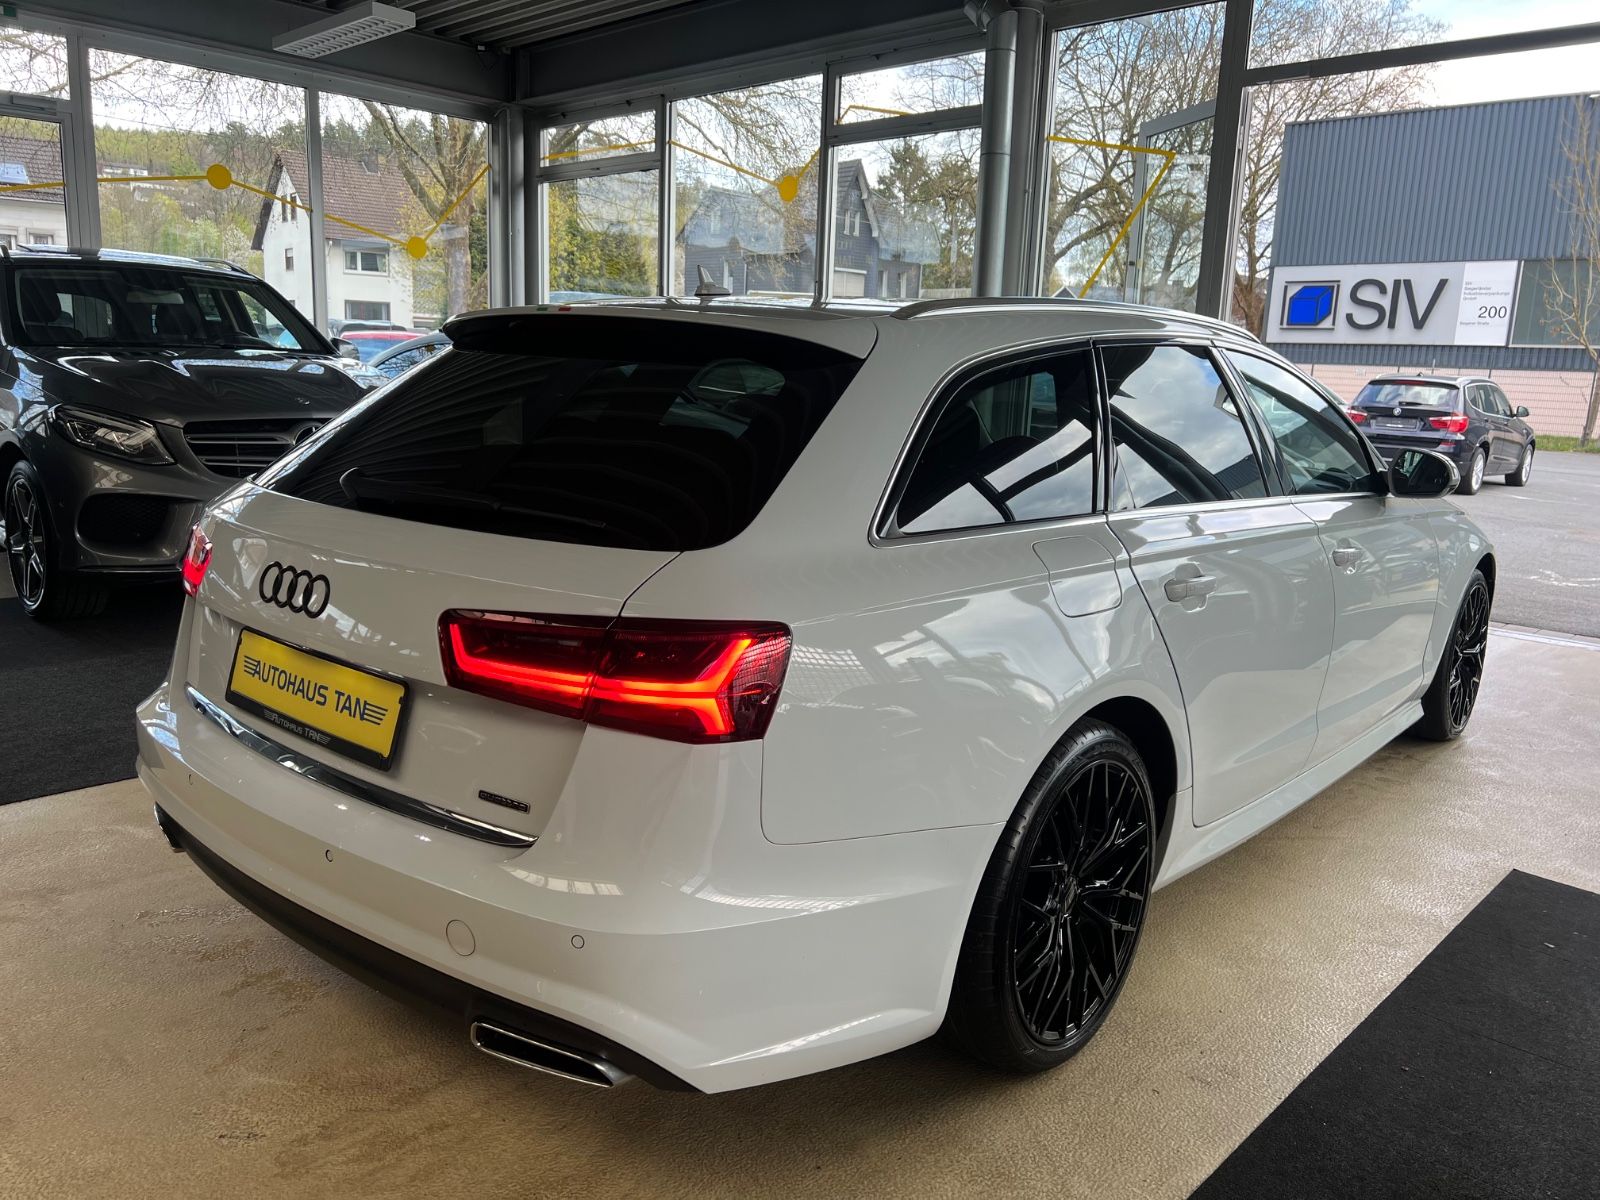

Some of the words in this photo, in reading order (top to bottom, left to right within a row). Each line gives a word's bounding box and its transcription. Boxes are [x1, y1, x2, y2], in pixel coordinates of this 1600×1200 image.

[1345, 278, 1449, 330] SIV
[1478, 305, 1508, 319] 200
[252, 660, 329, 706] AUTOHAUS
[335, 690, 368, 721] TAN
[304, 727, 321, 742] TAN
